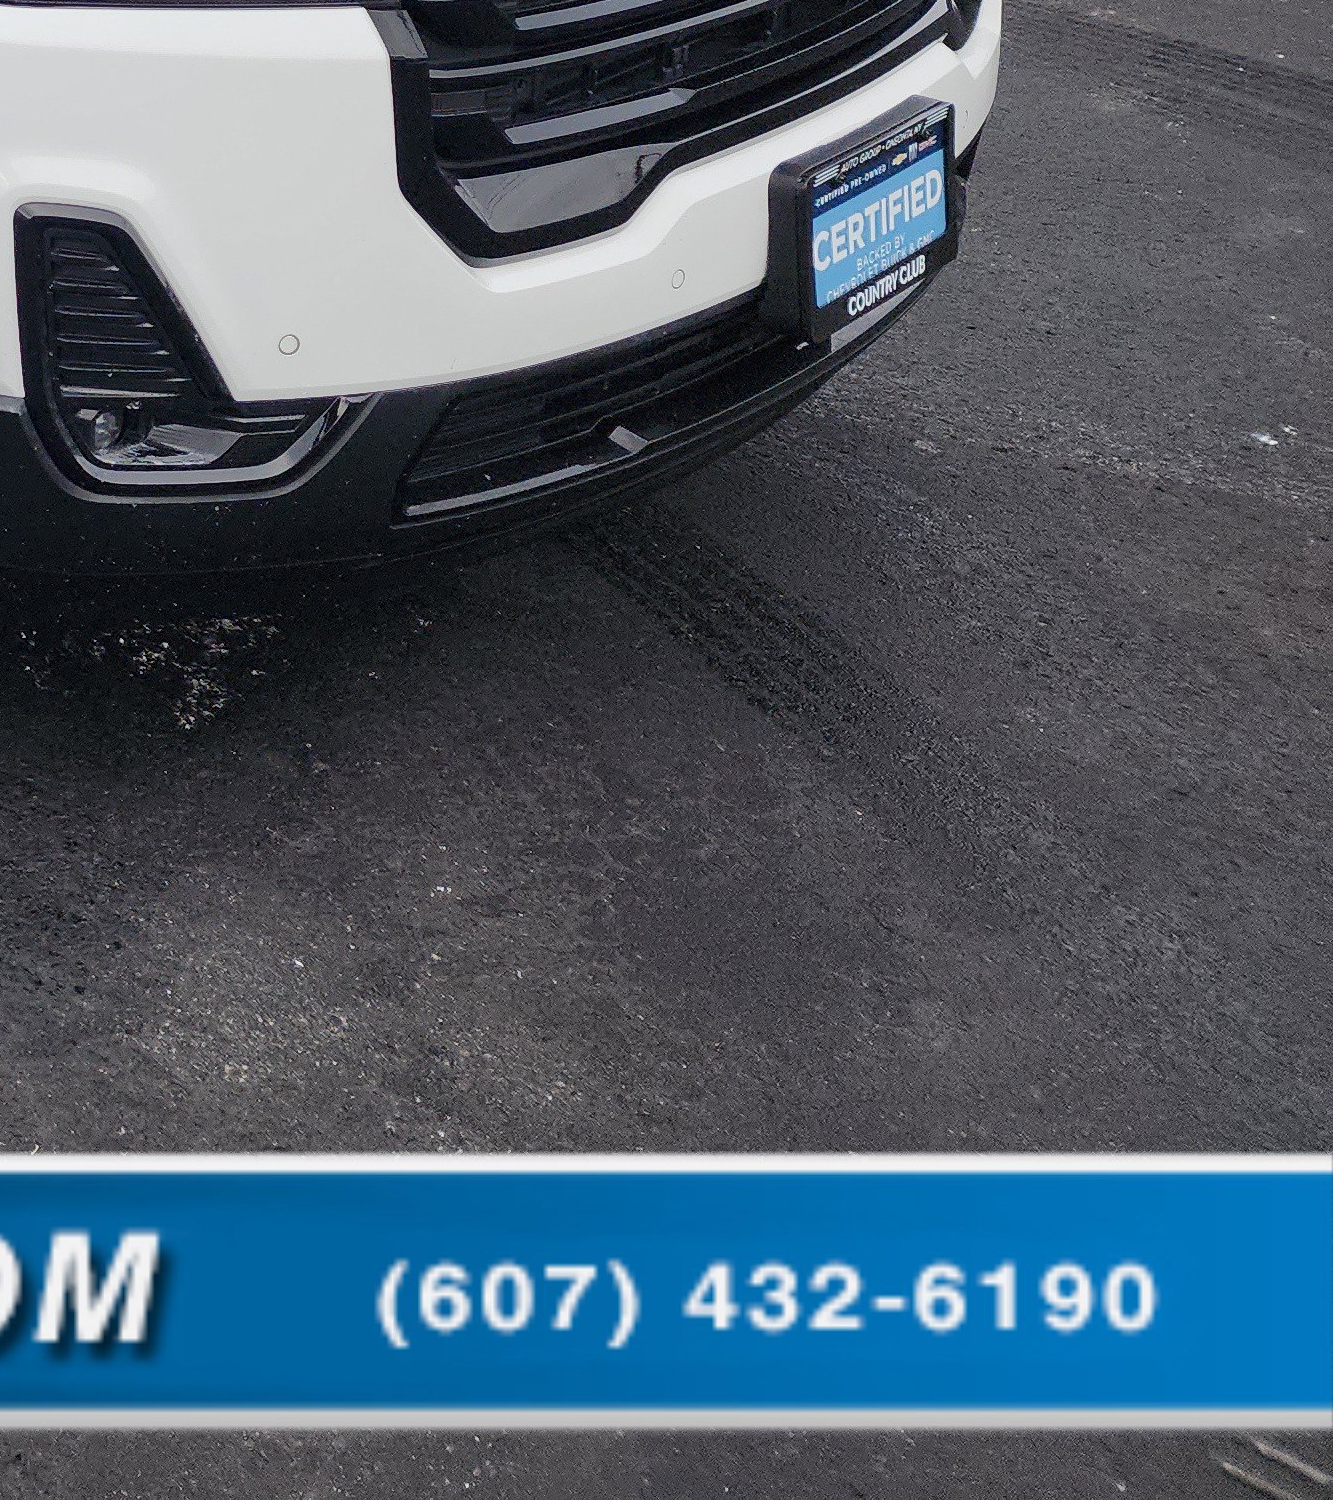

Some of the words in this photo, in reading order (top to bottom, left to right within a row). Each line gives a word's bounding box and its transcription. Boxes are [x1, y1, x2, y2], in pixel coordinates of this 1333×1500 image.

[812, 169, 944, 272] CERTIFIED
[856, 241, 892, 271] BACKED
[894, 234, 904, 249] BY
[848, 273, 899, 316] COUNTRY
[899, 254, 926, 285] CLUB
